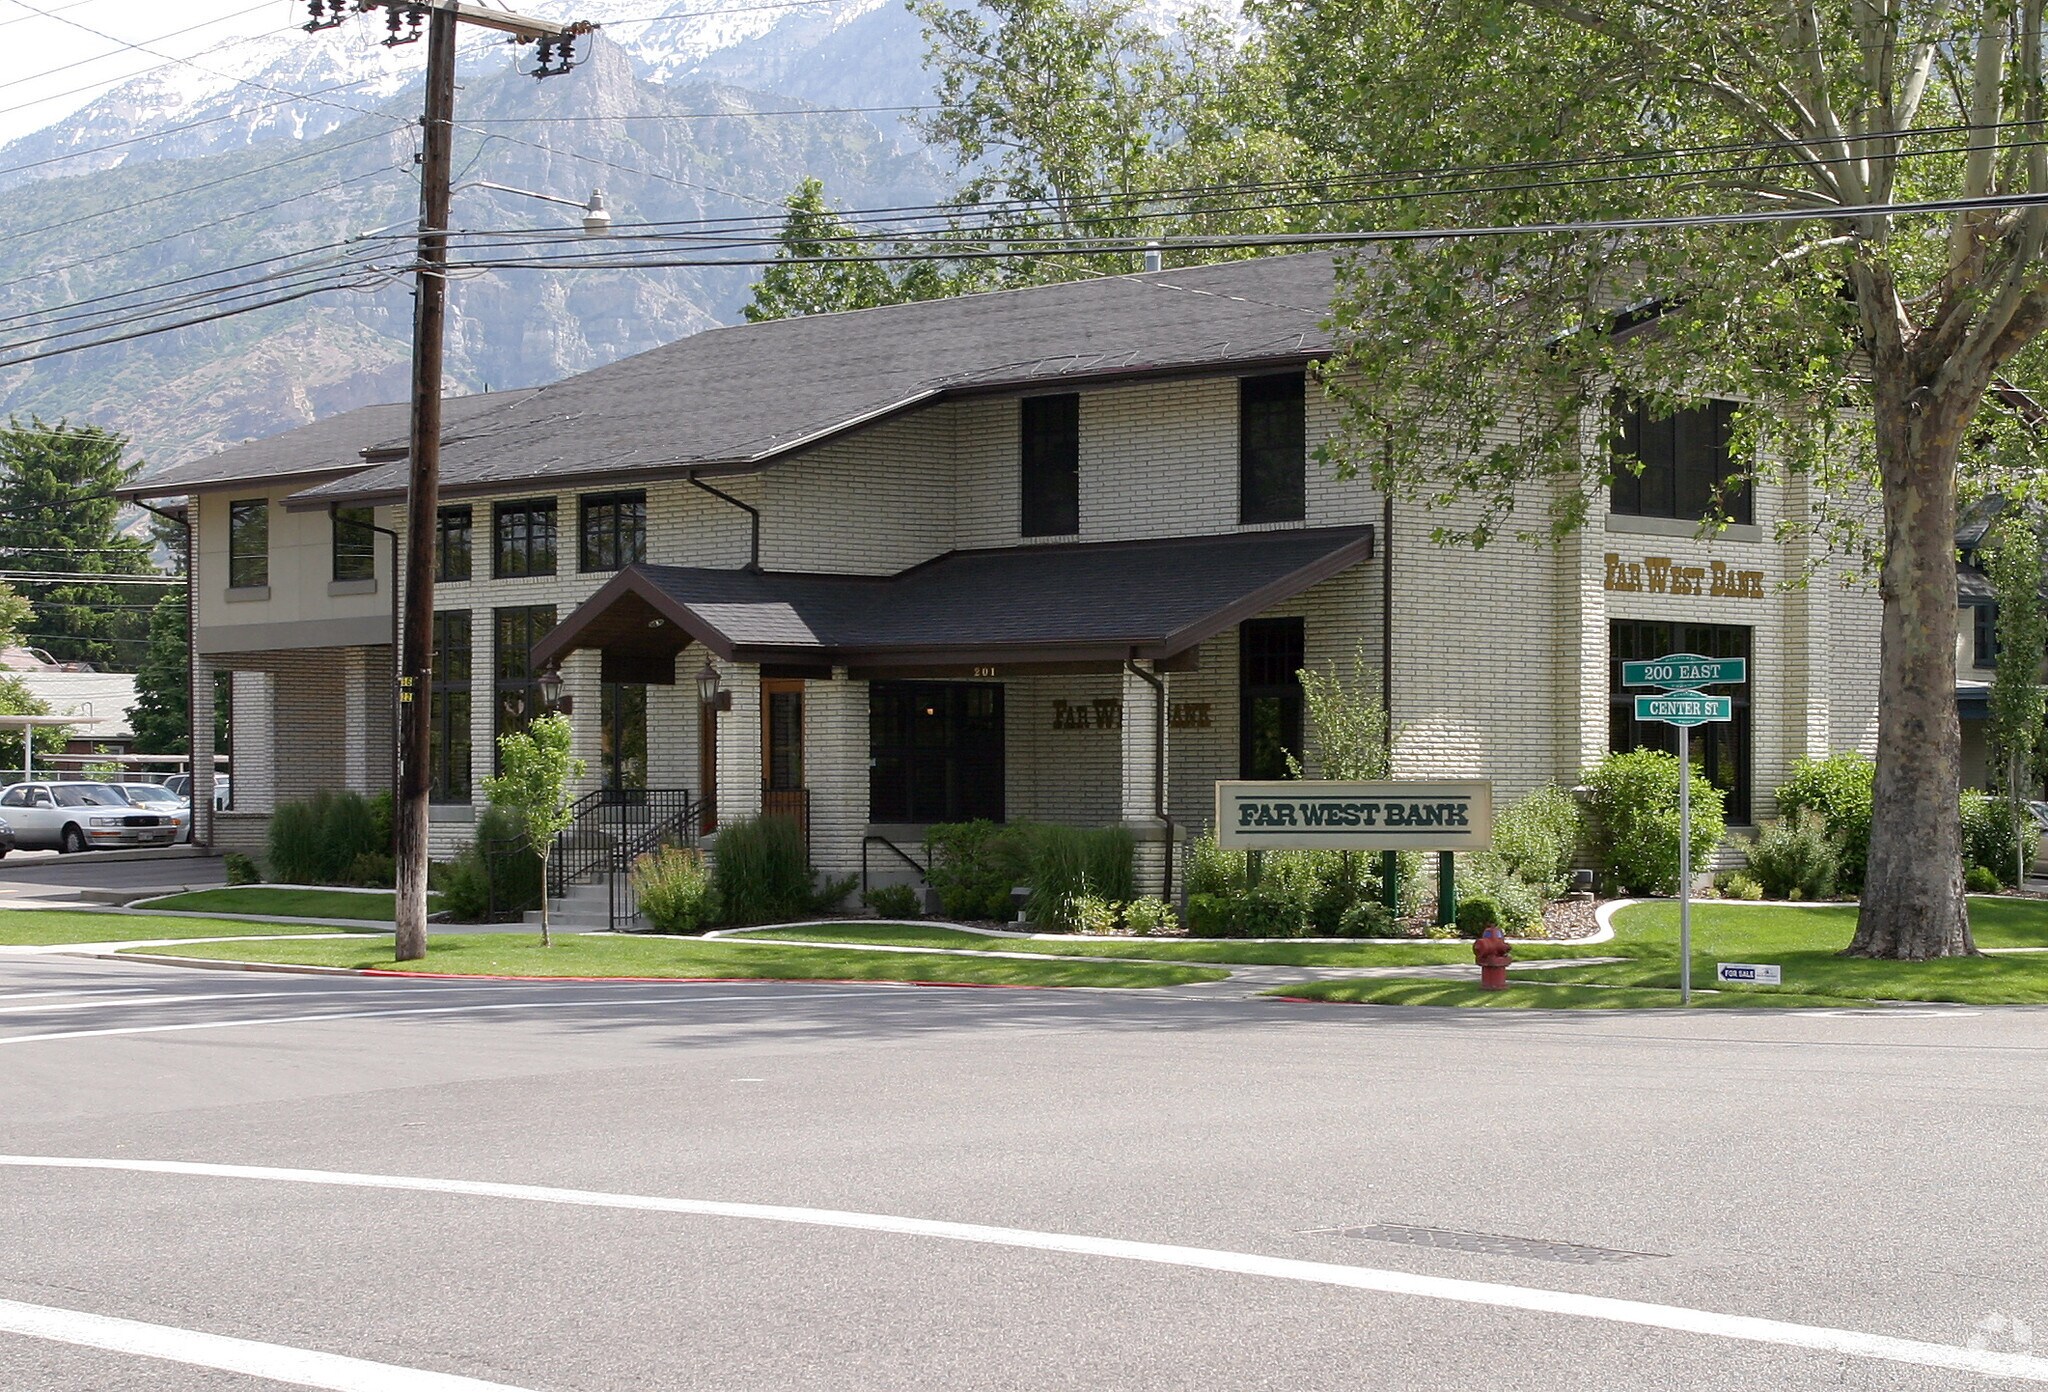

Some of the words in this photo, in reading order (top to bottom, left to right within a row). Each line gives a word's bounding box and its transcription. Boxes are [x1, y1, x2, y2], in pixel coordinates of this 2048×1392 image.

[1604, 553, 1642, 592] FAR
[1645, 557, 1705, 595] WEST
[1710, 561, 1764, 599] BANK
[973, 666, 996, 677] 201
[1644, 666, 1673, 680] 200
[1679, 664, 1721, 679] EAST
[1053, 699, 1089, 729] FAR
[1170, 702, 1212, 728] ANK
[1650, 701, 1701, 715] CENTER
[1704, 702, 1719, 715] ST
[1238, 803, 1298, 826] FAR
[1299, 803, 1381, 826] WEST
[1383, 803, 1469, 826] BANK
[1725, 969, 1738, 977] FOR
[1738, 969, 1754, 978] SALE
